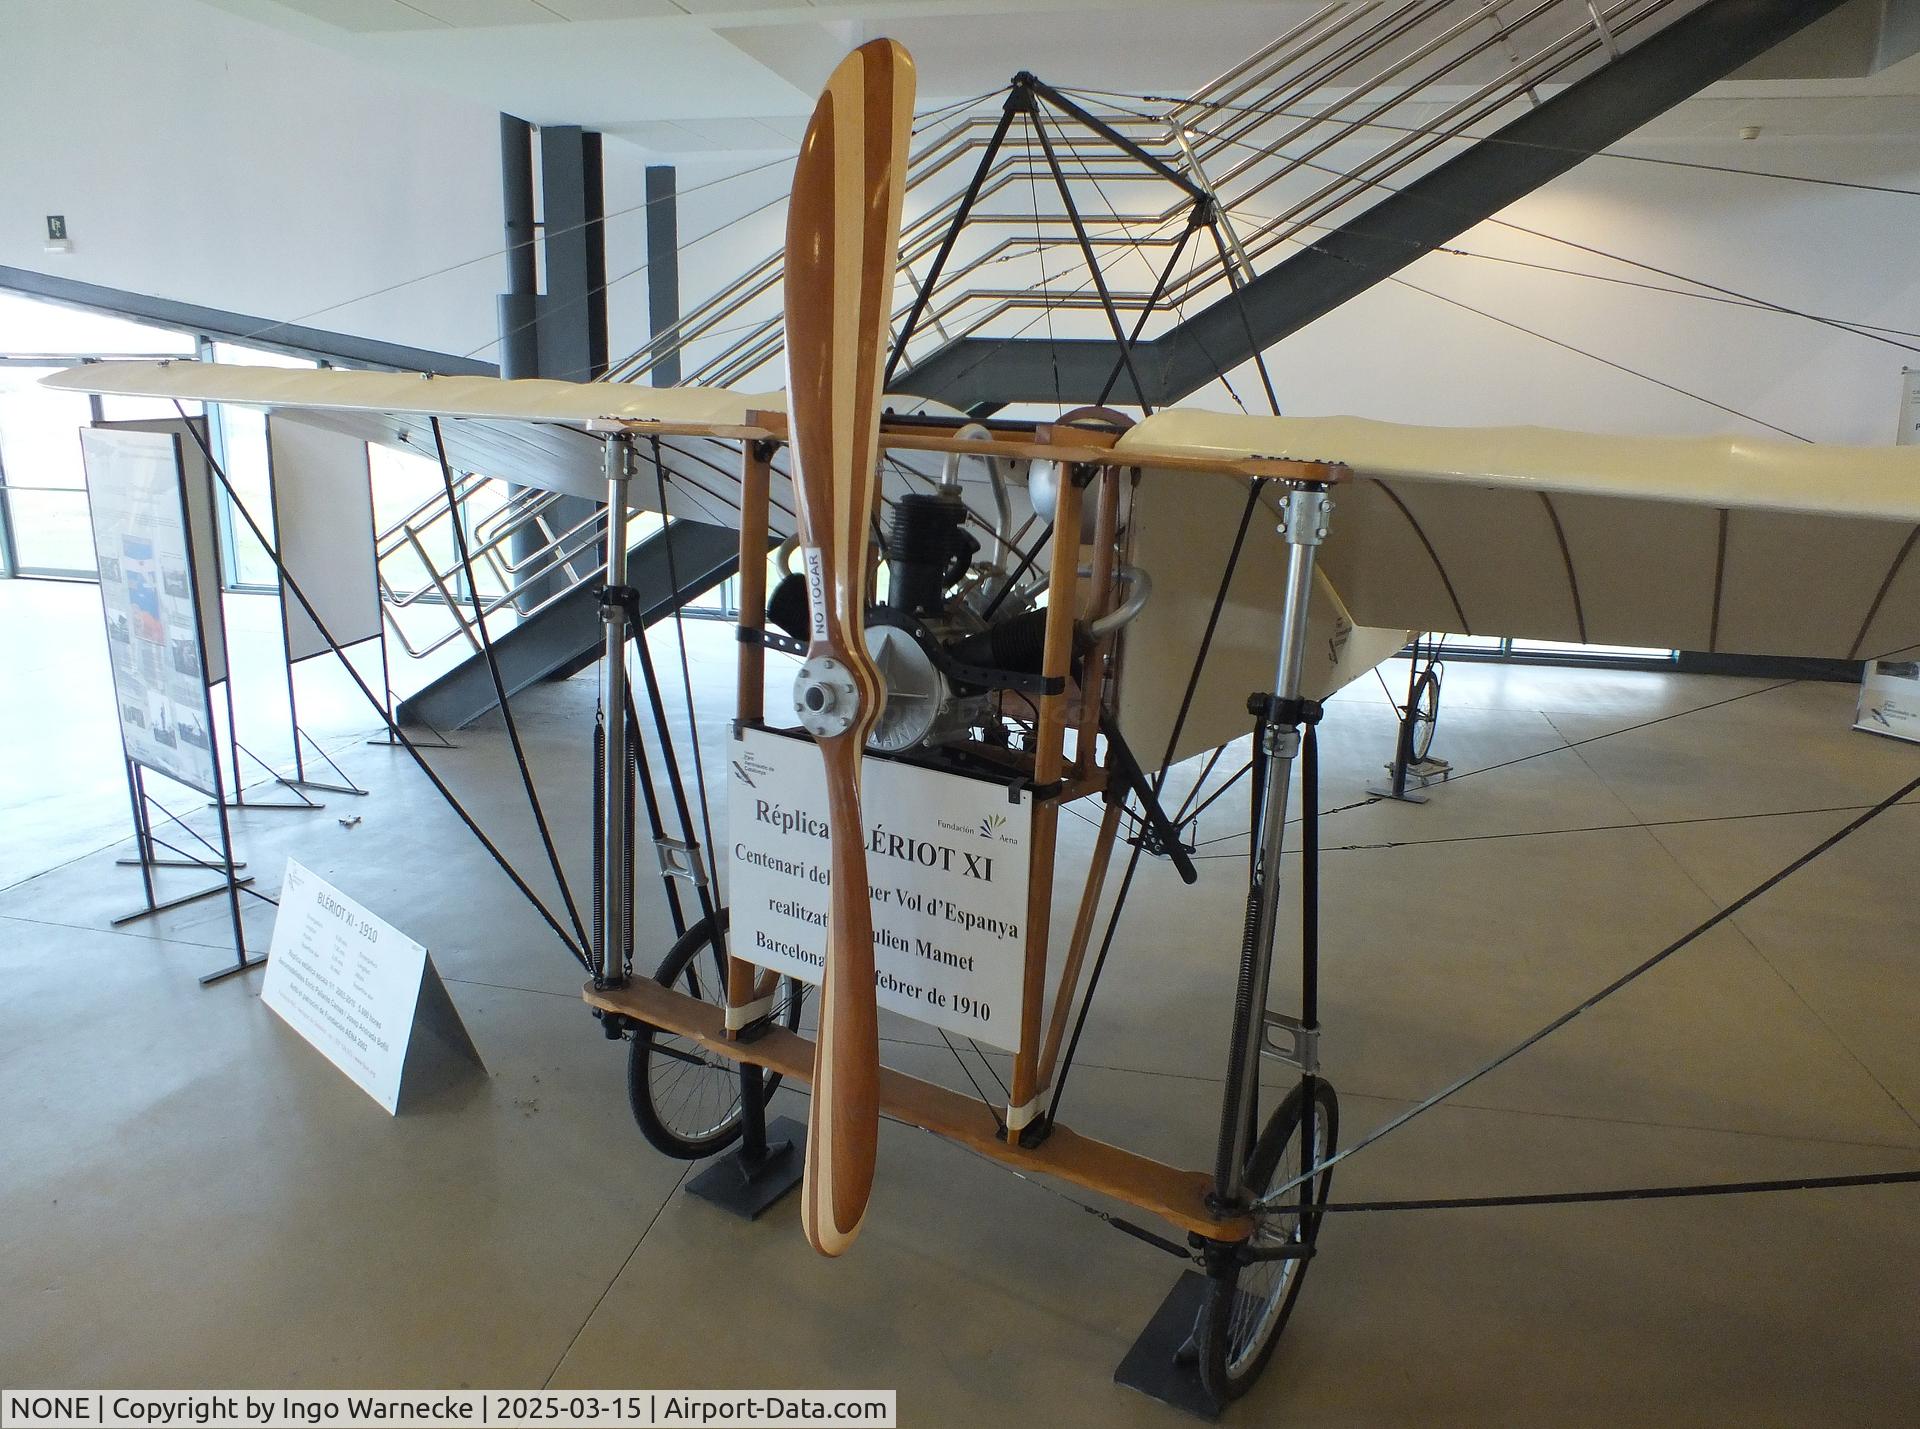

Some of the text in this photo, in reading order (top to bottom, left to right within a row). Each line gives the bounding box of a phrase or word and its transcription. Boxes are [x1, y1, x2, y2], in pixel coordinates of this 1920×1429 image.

[809, 554, 824, 634] NO TOCAR
[756, 799, 993, 882] Réplica ÉRIOT XI
[937, 819, 1018, 845] Fundación Aena
[735, 843, 831, 886] Centenari del
[317, 891, 346, 920] BLÉRIOT
[359, 921, 378, 943] 1910
[896, 888, 921, 912] Vol
[769, 898, 974, 972] realitzat ulien Mamet
[756, 930, 990, 1021] Barcelona febrer de 1910
